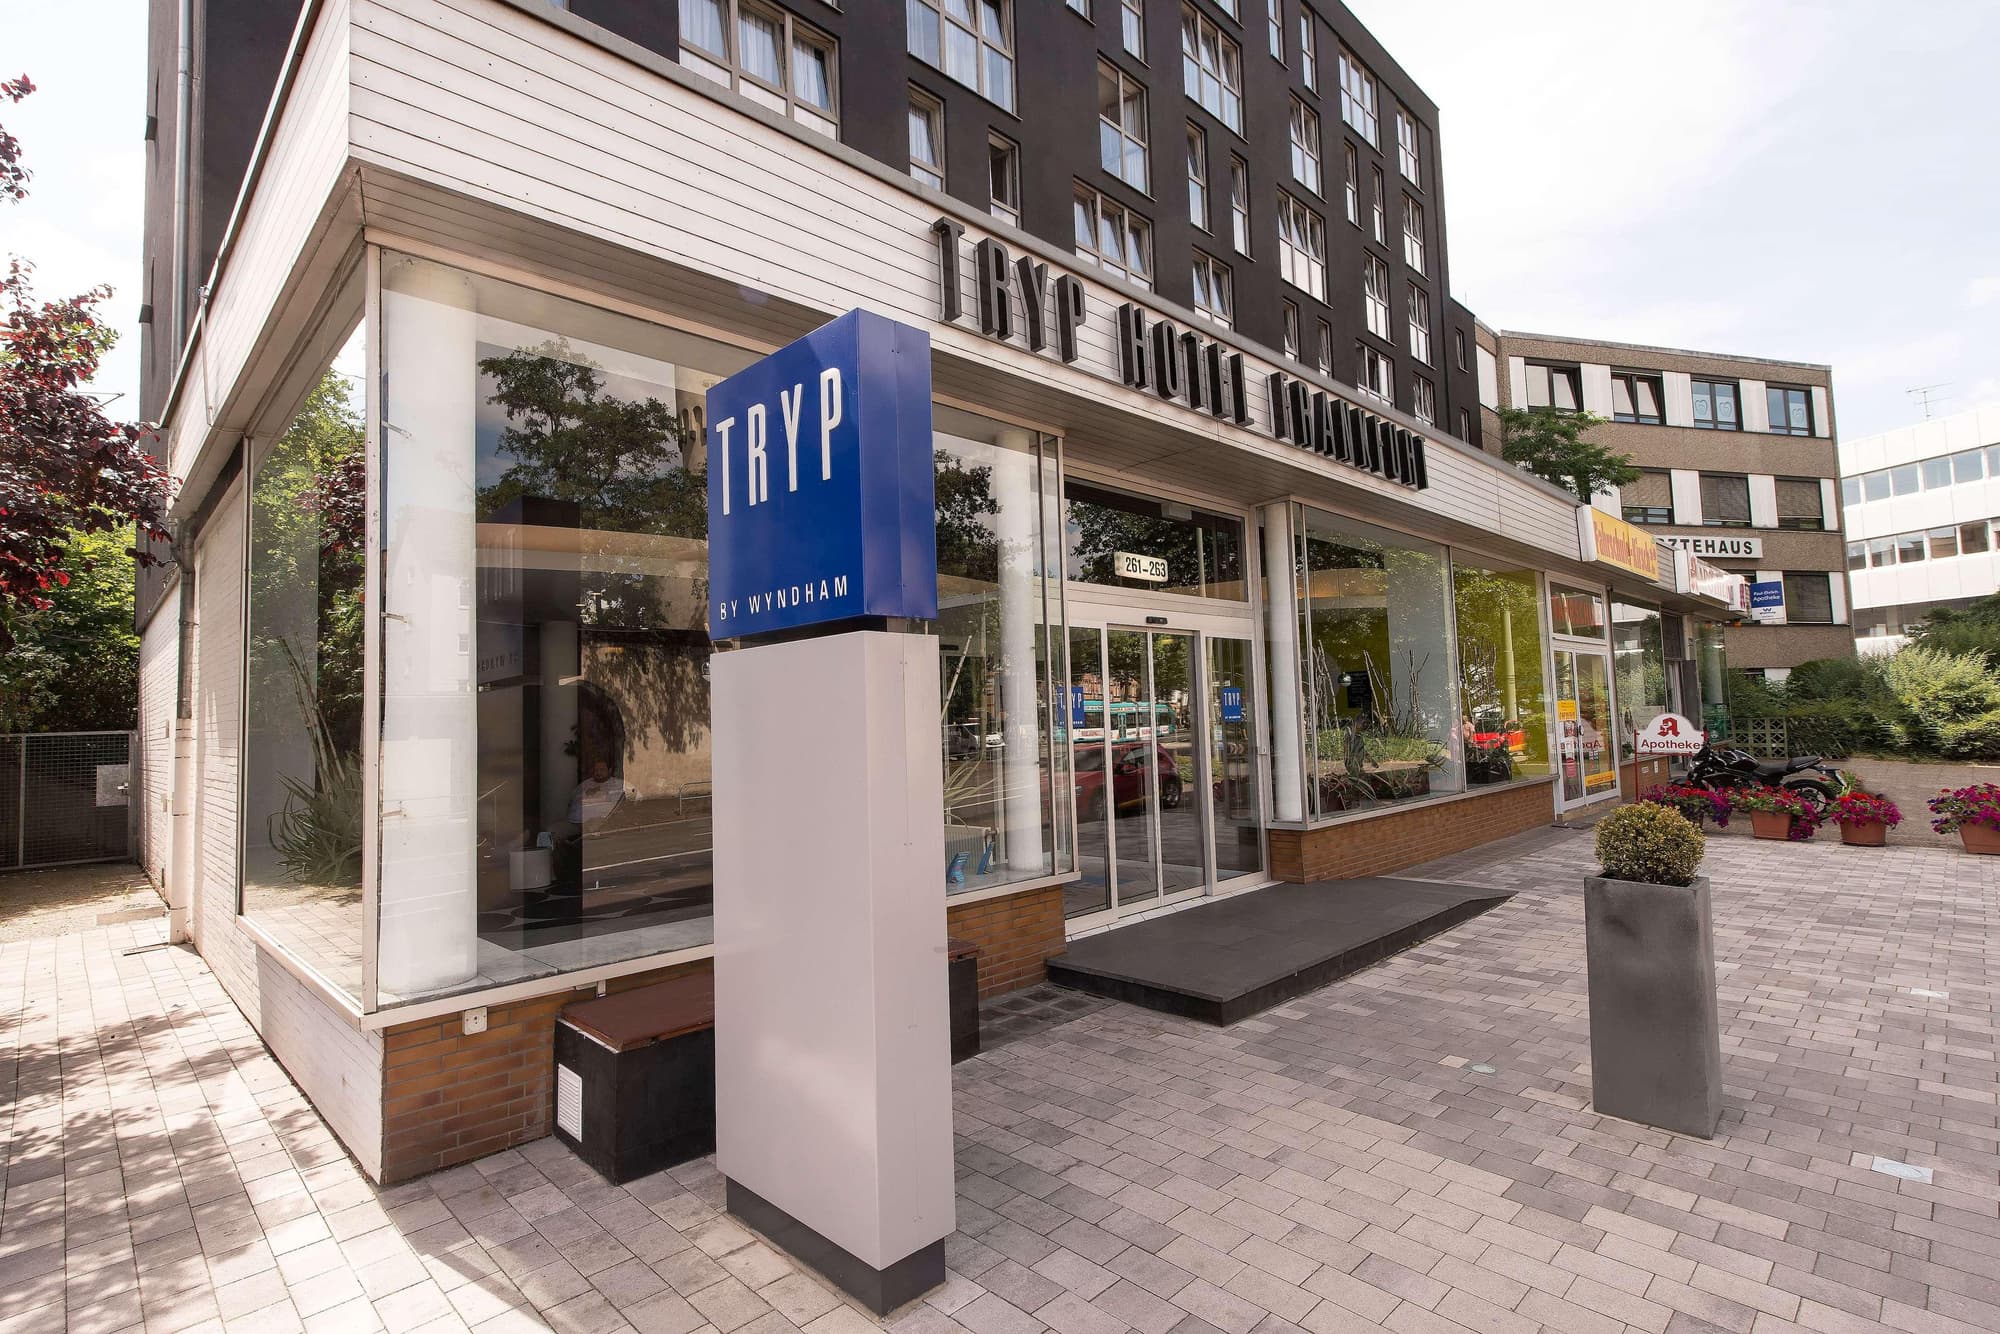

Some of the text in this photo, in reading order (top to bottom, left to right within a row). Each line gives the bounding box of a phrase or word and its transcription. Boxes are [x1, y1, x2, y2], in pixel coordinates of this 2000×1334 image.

[930, 216, 1429, 491] TRYP HOTEL FRANKFURT
[715, 367, 843, 516] TRYP
[1656, 538, 1753, 555] ZTEHAUS
[1125, 556, 1166, 577] 261-263
[720, 575, 848, 621] BY WYNDHAM
[1641, 738, 1701, 752] Apotheke
